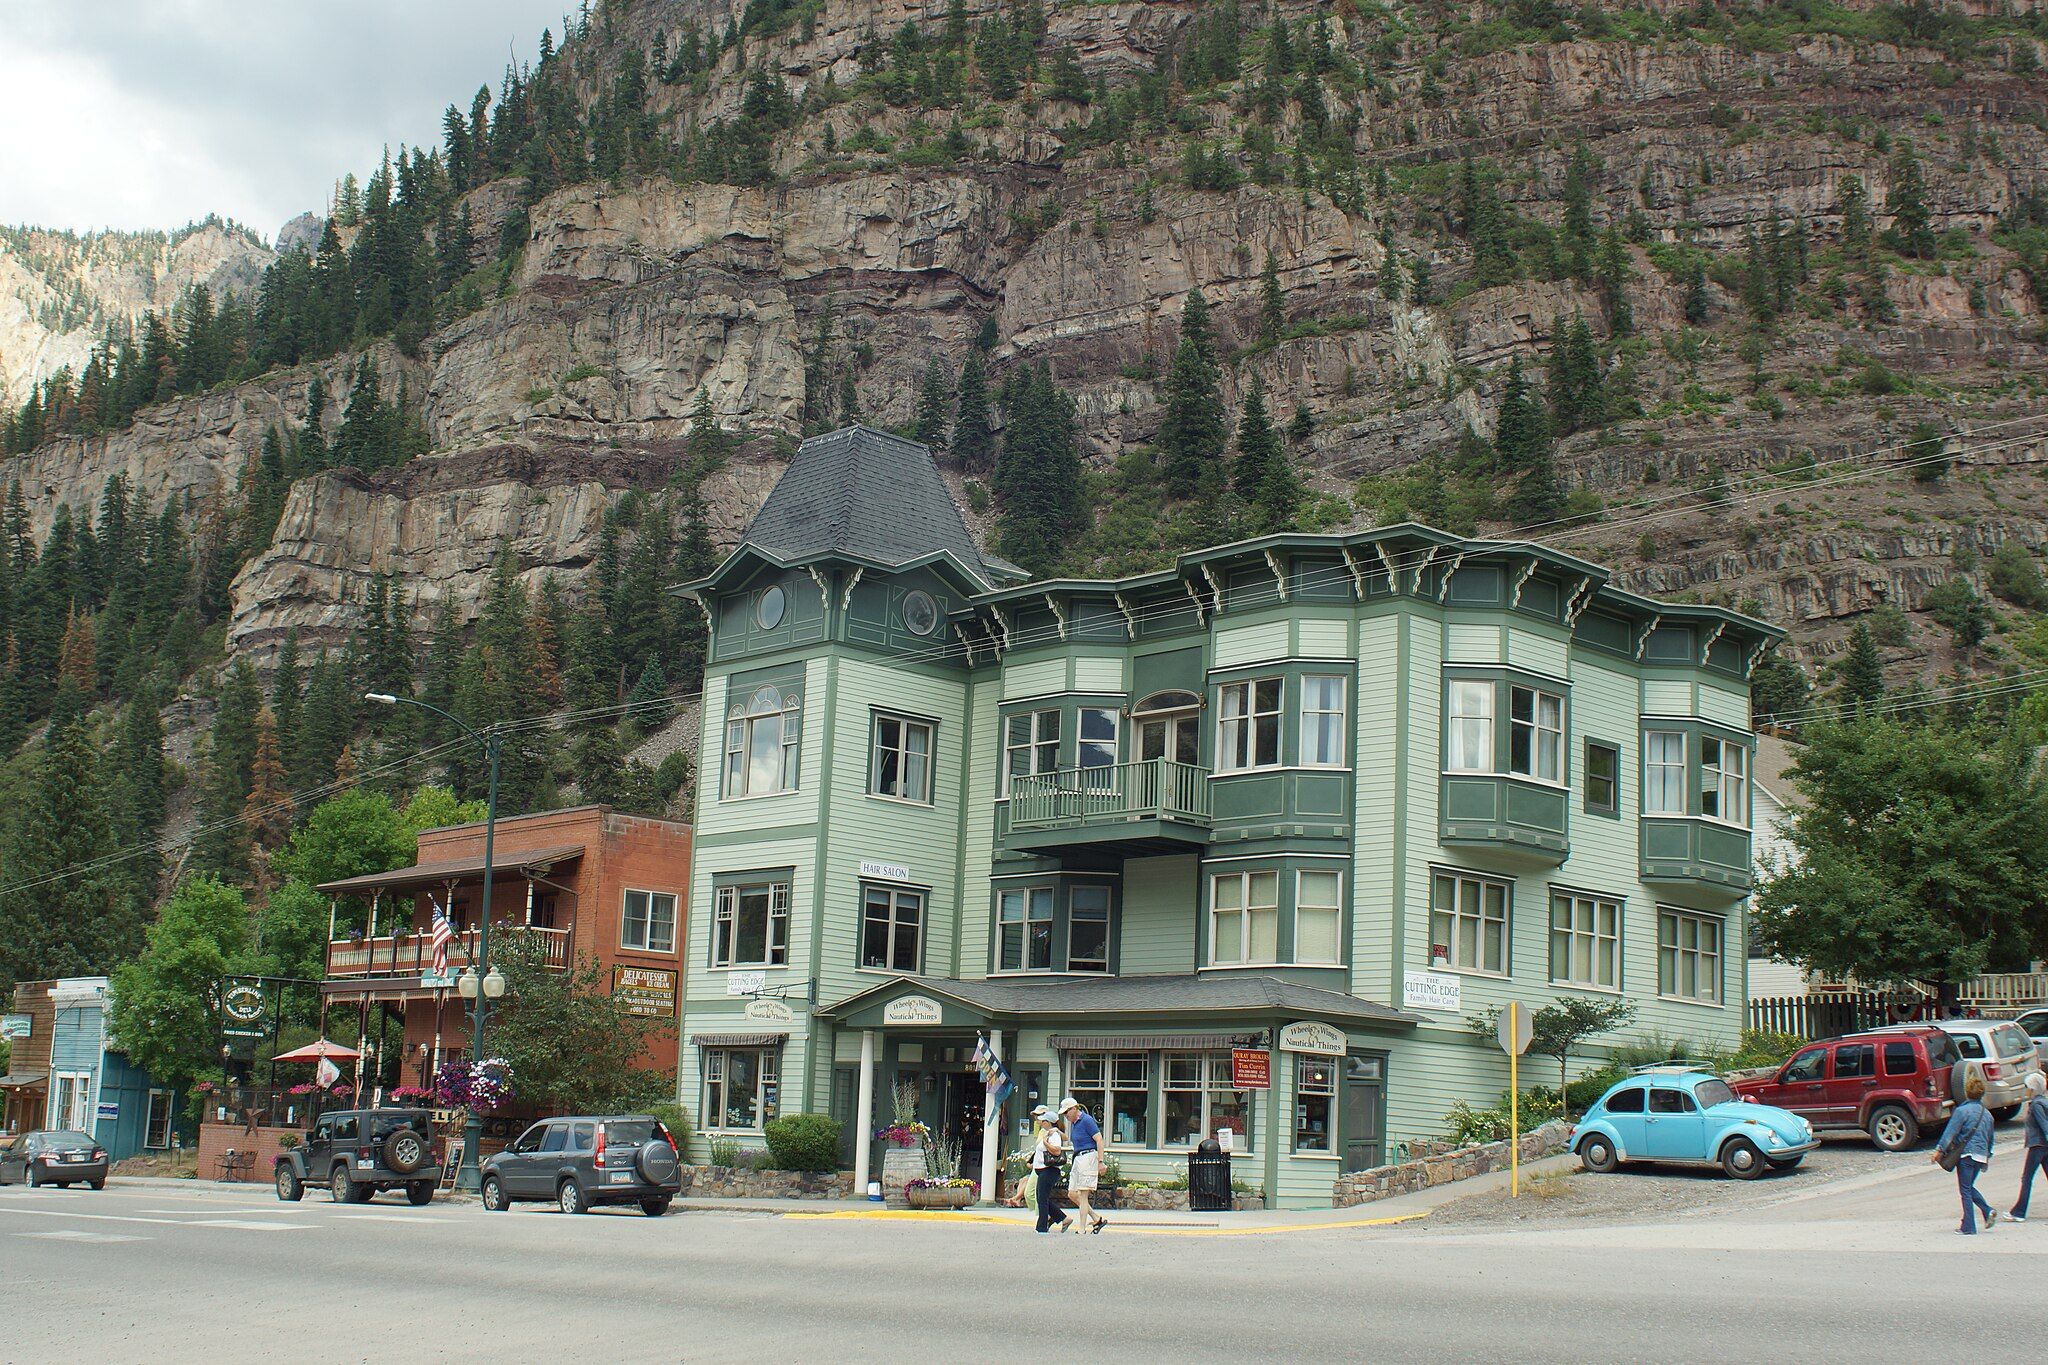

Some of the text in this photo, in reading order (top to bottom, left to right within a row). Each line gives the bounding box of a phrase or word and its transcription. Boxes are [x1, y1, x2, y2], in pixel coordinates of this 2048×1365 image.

[863, 863, 907, 878] HAIR SALON
[624, 970, 668, 982] DELICATESSEN
[1405, 982, 1459, 996] CUTTING EDGE
[1410, 994, 1427, 1002] Family
[918, 999, 934, 1011] Wings
[916, 1013, 937, 1021] Things
[1290, 1025, 1338, 1040] Wheels Wings
[1286, 1038, 1341, 1051] Nautical Things
[978, 1058, 997, 1087] OPEN
